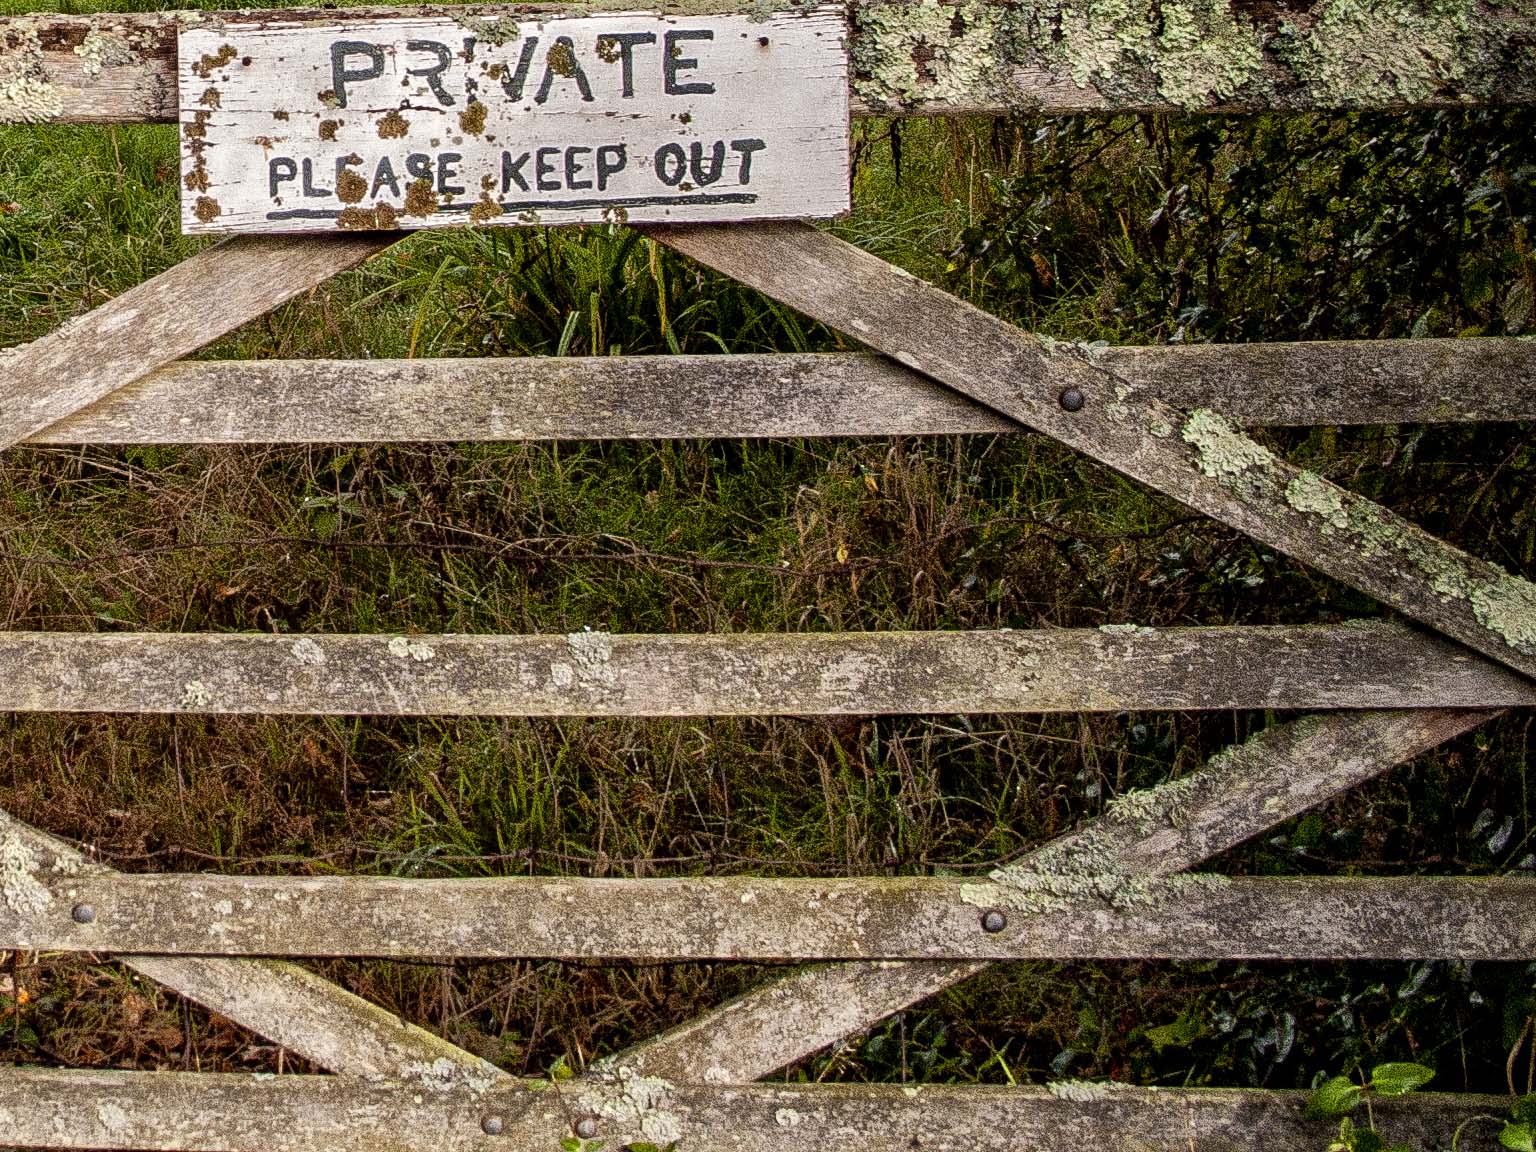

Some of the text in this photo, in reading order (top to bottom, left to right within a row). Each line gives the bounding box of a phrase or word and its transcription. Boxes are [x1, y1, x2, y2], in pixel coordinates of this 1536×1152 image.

[330, 29, 715, 108] PRIVATE
[501, 144, 627, 193] KEEP
[654, 138, 766, 186] OUT
